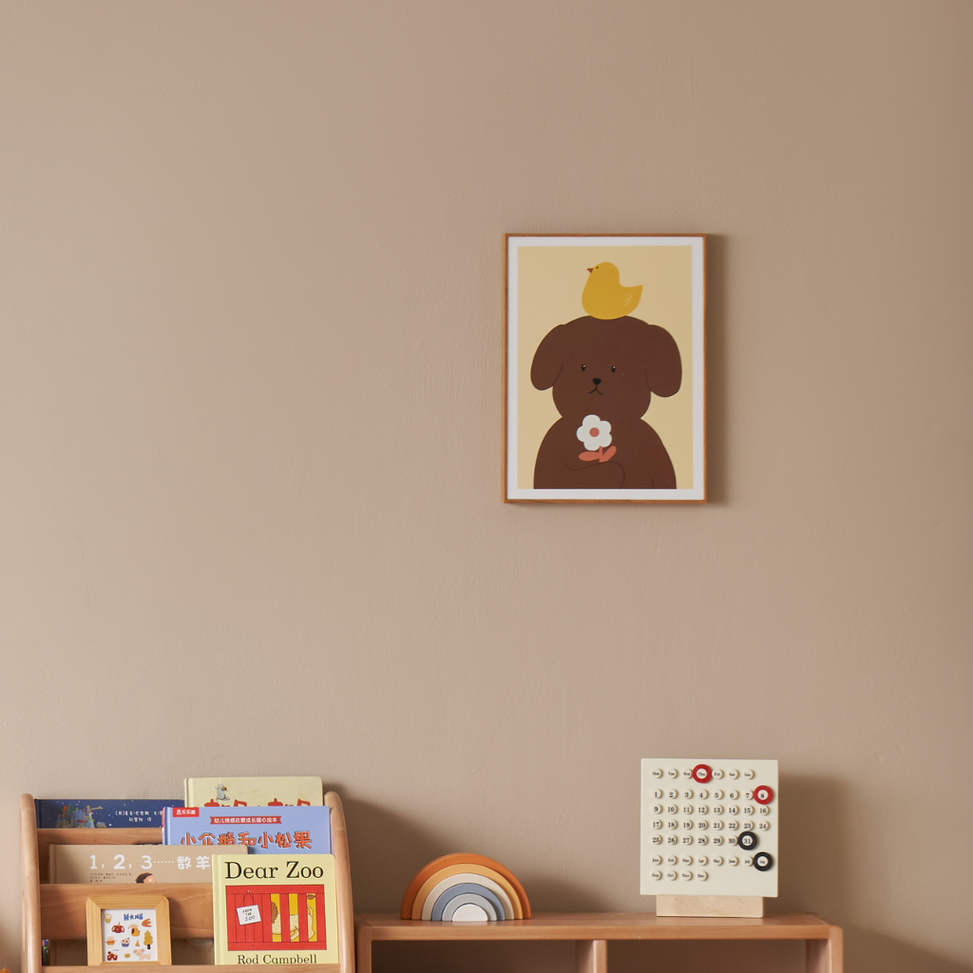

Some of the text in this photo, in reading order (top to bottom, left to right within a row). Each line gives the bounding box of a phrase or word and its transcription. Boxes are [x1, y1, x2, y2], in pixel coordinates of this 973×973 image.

[225, 861, 323, 879] Dear Zoo
[237, 954, 317, 965] Rod Campbell
